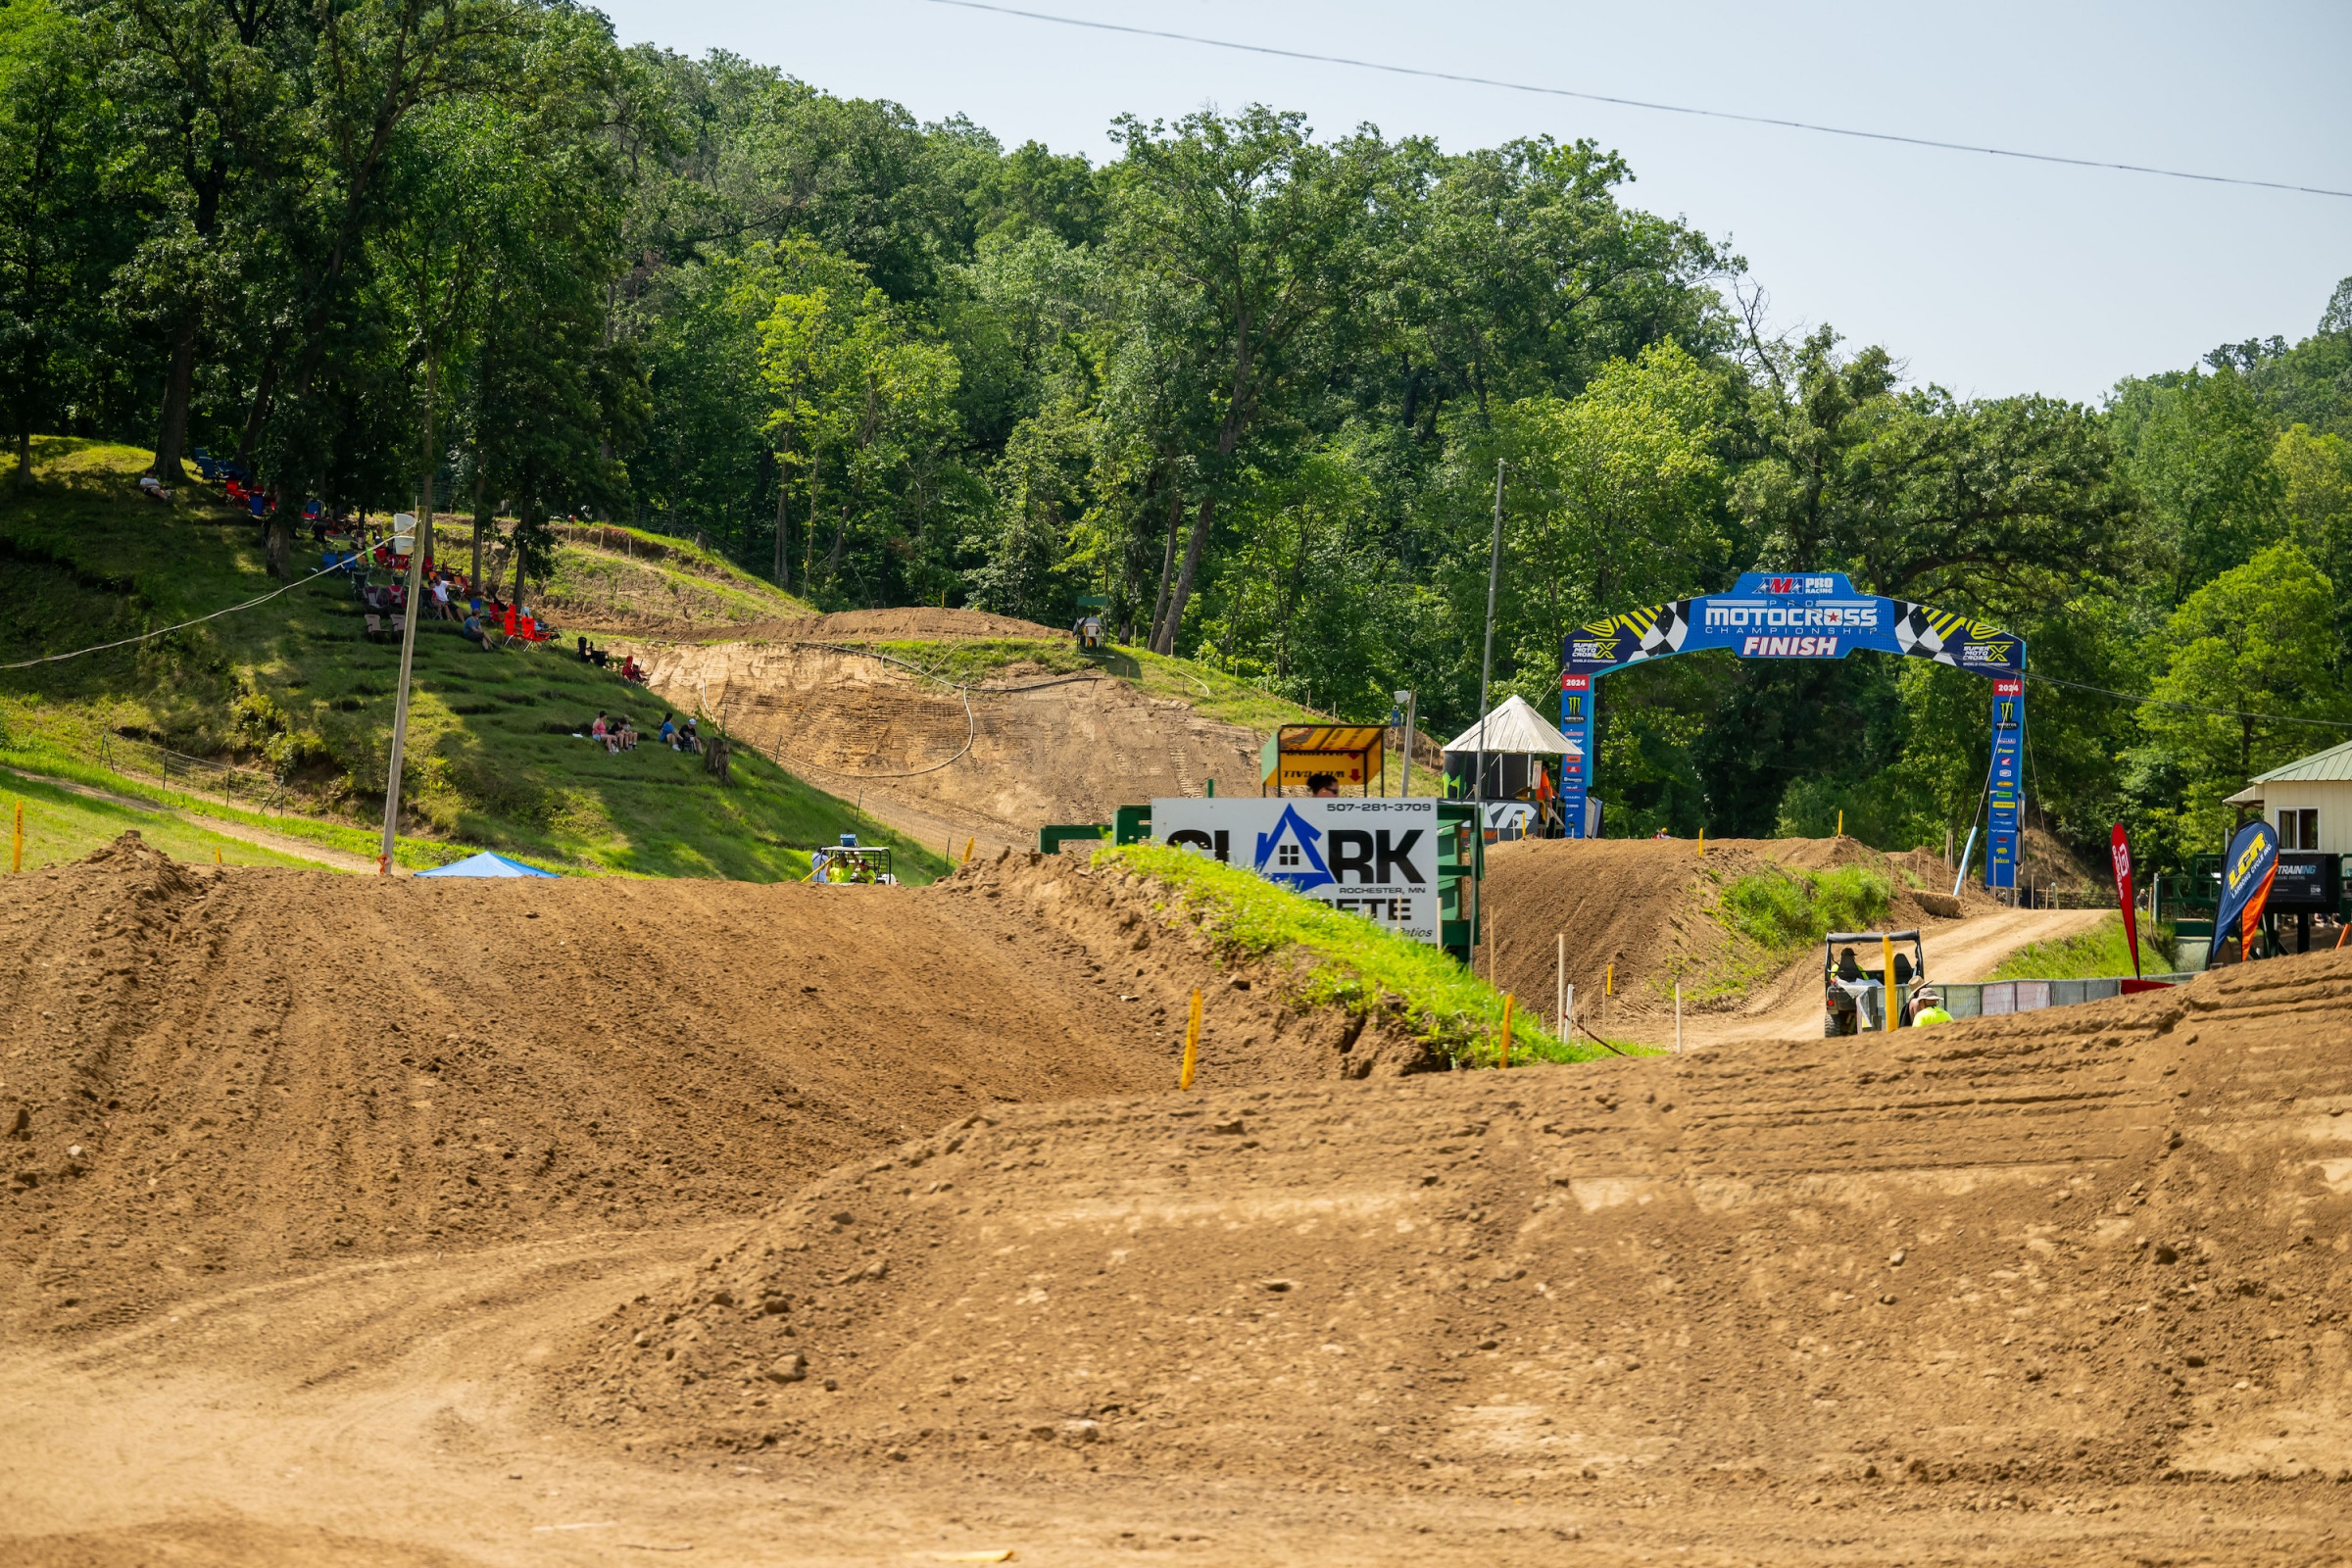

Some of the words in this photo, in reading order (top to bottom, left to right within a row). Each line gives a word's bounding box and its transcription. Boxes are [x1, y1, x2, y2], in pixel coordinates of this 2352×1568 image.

[1752, 577, 1804, 594] AMA
[1805, 577, 1834, 588] PRO
[1705, 608, 1878, 626] MOTOCROSS
[1742, 636, 1838, 657] FINISH
[2228, 831, 2267, 892] LCR
[2250, 854, 2264, 873] CYCLE
